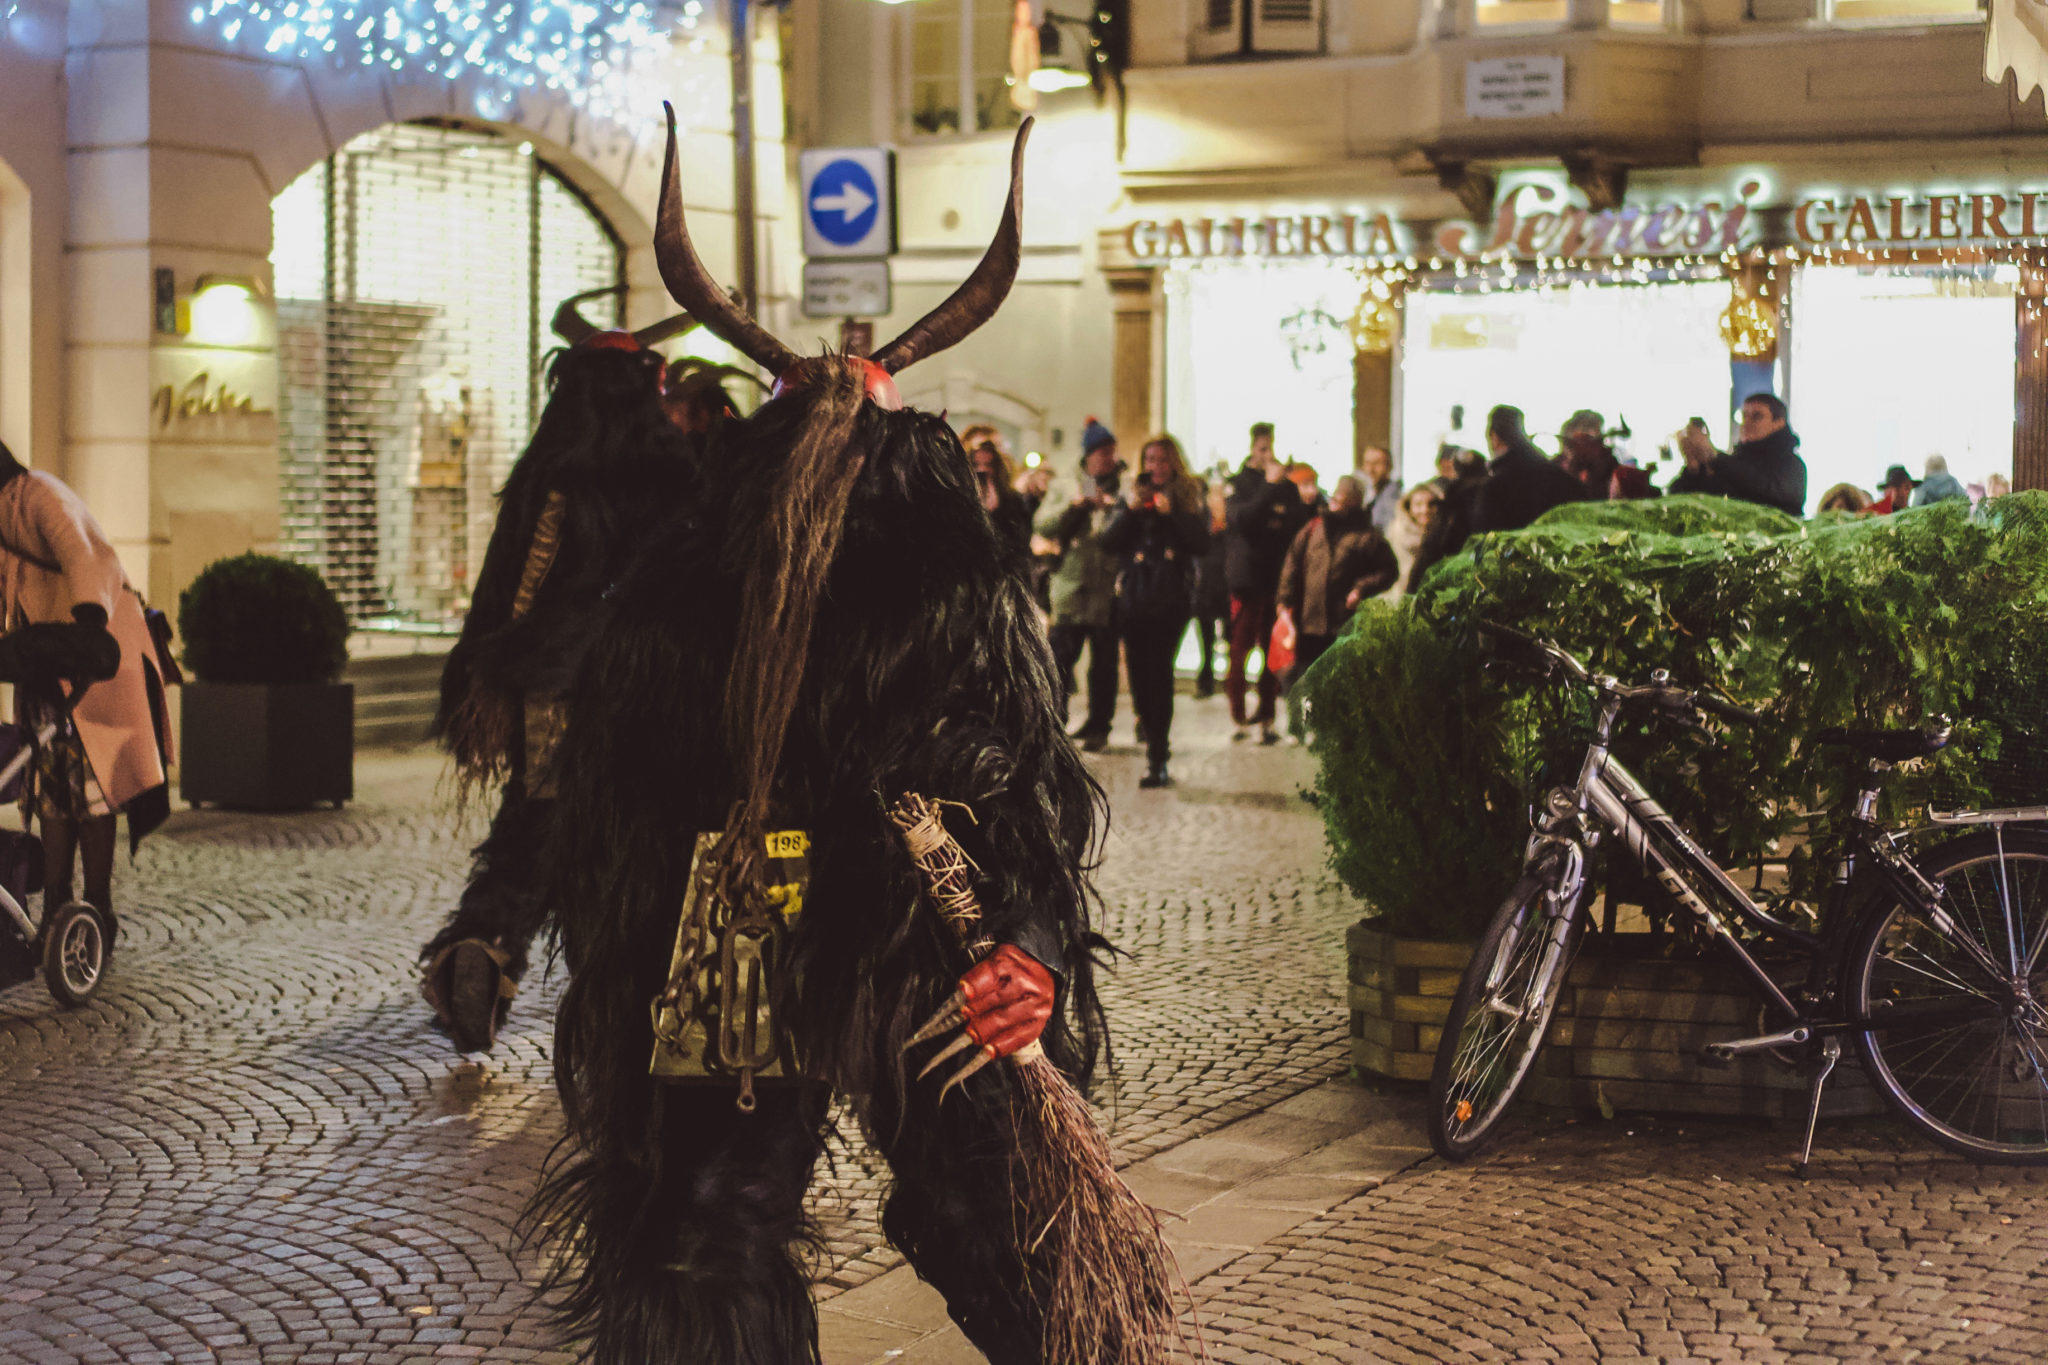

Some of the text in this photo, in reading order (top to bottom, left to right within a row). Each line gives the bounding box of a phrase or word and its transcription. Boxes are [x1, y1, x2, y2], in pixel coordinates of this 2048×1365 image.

[1125, 213, 1397, 257] GALLERIA
[1795, 192, 2048, 243] GALERI
[772, 835, 801, 852] 198
